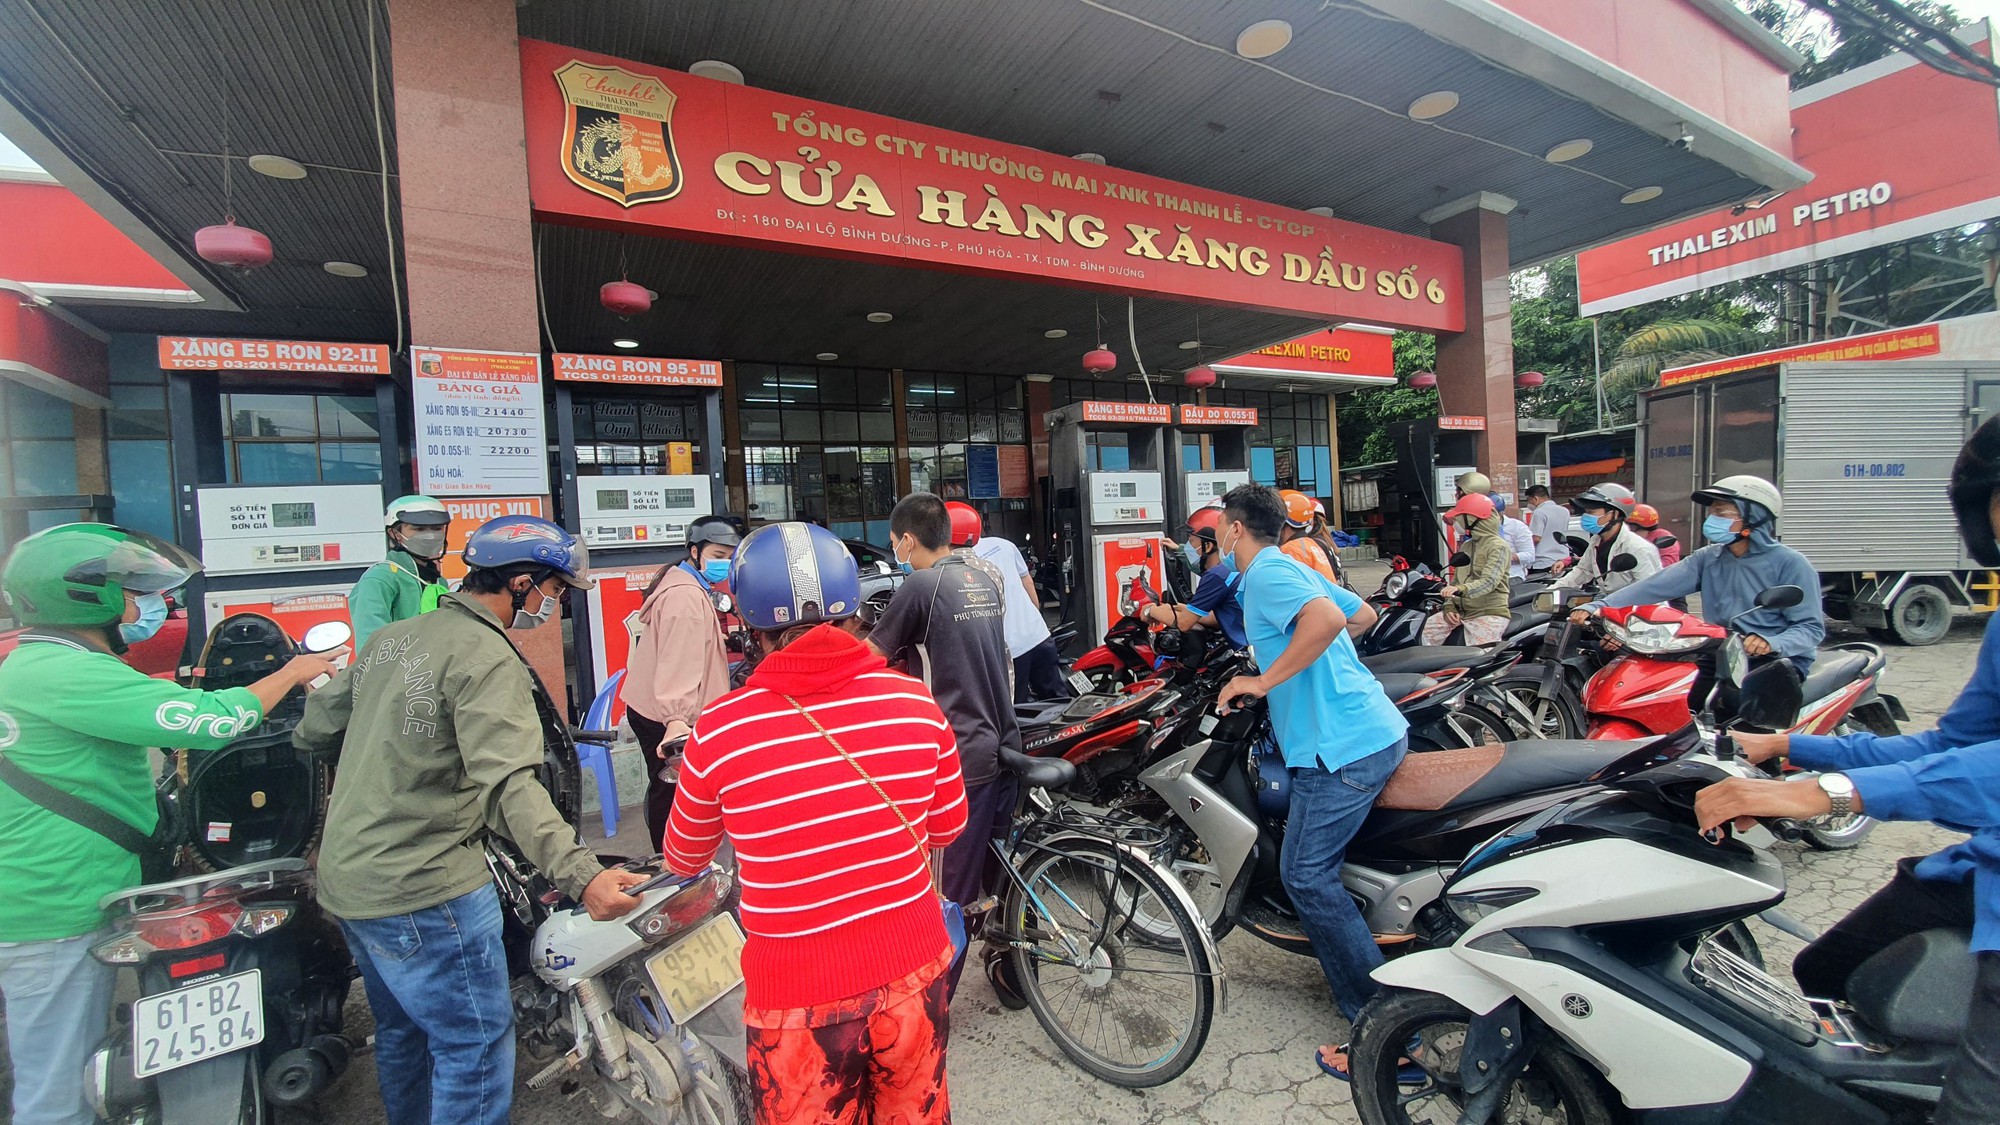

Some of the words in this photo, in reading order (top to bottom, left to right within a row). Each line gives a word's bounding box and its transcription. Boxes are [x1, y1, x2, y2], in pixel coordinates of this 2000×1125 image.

[600, 95, 638, 108] THALEXIM
[772, 110, 867, 146] TỔNG
[875, 134, 927, 159] CTY
[935, 146, 1044, 182] THƯƠNG
[1052, 170, 1098, 195] MẠI
[1103, 181, 1149, 205] XNK
[1153, 192, 1220, 219] THANH
[1223, 202, 1243, 225] LỄ
[1257, 214, 1315, 238] CTCP
[714, 146, 896, 217] CỬA
[916, 183, 1109, 248] HÀNG
[1125, 223, 1271, 276] XĂNG
[1283, 245, 1367, 292] DẦU
[1376, 264, 1419, 300] SỐ
[1426, 278, 1445, 304] 6
[1648, 213, 1777, 267] THALEXIM
[1793, 181, 1893, 227] PETRO
[753, 214, 779, 227] 180
[785, 218, 810, 232] ĐẠI
[816, 221, 836, 237] LỘ
[842, 225, 876, 241] BÌNH
[958, 242, 983, 255] PHÚ
[988, 245, 1013, 259] HÒA
[1046, 256, 1070, 268] TDM
[1080, 259, 1106, 273] BÌNH
[1108, 265, 1145, 279] DƯƠNG
[171, 338, 235, 358] XĂNG
[242, 343, 269, 358] E5
[276, 344, 322, 361] RON
[328, 348, 378, 363] 92-II
[1310, 345, 1351, 362] PETRO
[172, 359, 218, 368] TCCS
[223, 360, 378, 373] 03:2015/THALEXIM
[560, 355, 617, 371] XĂNG
[622, 360, 662, 374] RON
[562, 371, 598, 380] TCCS
[601, 373, 717, 385] 01:2015/THALEXIM
[437, 381, 485, 393] BẢNG
[491, 384, 521, 395] GIÁ
[425, 402, 444, 415] XĂNG
[446, 405, 460, 416] RON
[484, 407, 524, 416] 21440
[1088, 402, 1112, 414] XĂNG
[1115, 405, 1126, 414] E5
[1128, 406, 1145, 415] RON
[1147, 406, 1167, 416] 92-II
[1208, 410, 1220, 419] DO
[427, 423, 443, 436] XĂNG
[444, 426, 452, 436] E5
[453, 426, 465, 436] RON
[488, 427, 527, 436] 20730
[428, 445, 438, 455] DO
[490, 446, 530, 454] 22200
[1844, 463, 1905, 478] 61H-00.802
[448, 502, 501, 522] PHỤC
[156, 700, 258, 738] Grab
[182, 972, 221, 986] HONDA
[157, 981, 241, 1030] 61-B2
[144, 1011, 256, 1071] 245.84
